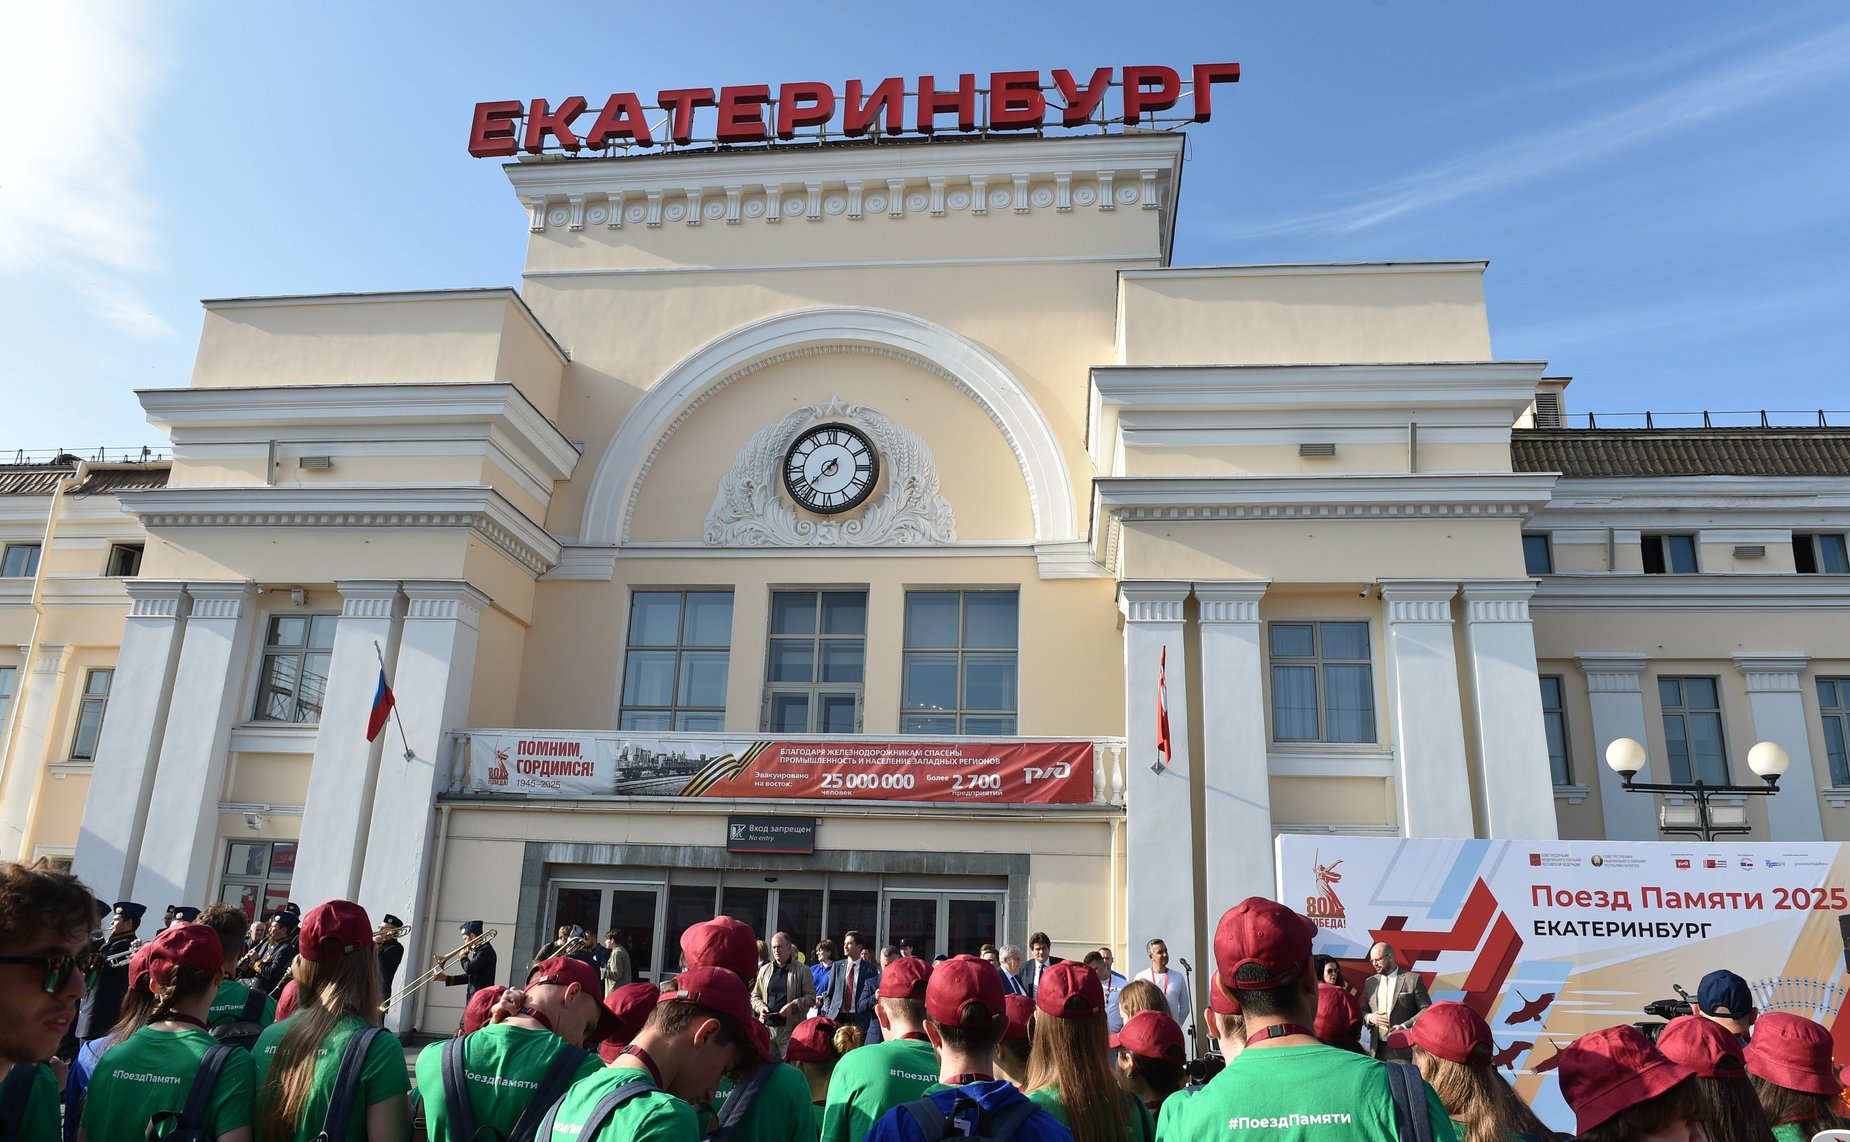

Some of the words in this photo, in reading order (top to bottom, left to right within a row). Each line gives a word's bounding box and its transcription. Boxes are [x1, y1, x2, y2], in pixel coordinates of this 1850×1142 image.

[467, 62, 1240, 159] ЕКАТЕРИНБУРГ
[517, 740, 583, 759] ПОМНИМ,
[780, 748, 826, 756] БЛАГОДАРЯ
[827, 749, 922, 757] ЖЕЛЕЗНОДОРОЖНИКАМ
[924, 749, 962, 757] СПАСЕНЫ
[516, 760, 595, 777] ГОРДИМСЯ!
[913, 758, 957, 766] ЗАПАДНЫХ
[488, 767, 500, 779] 80
[755, 772, 809, 780] Эвакуировано
[821, 773, 843, 789] 25
[845, 773, 879, 789] 000
[881, 773, 915, 789] 000
[952, 774, 963, 790] 2
[967, 774, 1001, 789] 700
[749, 824, 769, 833] Вход
[770, 825, 811, 834] запрещен
[758, 835, 775, 843] entry
[1306, 896, 1328, 915] 80
[1531, 885, 1632, 911] Поезд
[1641, 887, 1764, 910] Памяти
[1772, 887, 1848, 910] 2025
[1311, 917, 1347, 929] ОБЕДА!
[1533, 920, 1712, 938] ЕКАТЕРИНБУРГ
[112, 1069, 181, 1084] #ПоездПамяти
[889, 1068, 940, 1082] #ПоездП
[1228, 1112, 1351, 1130] #ПоездПамяти
